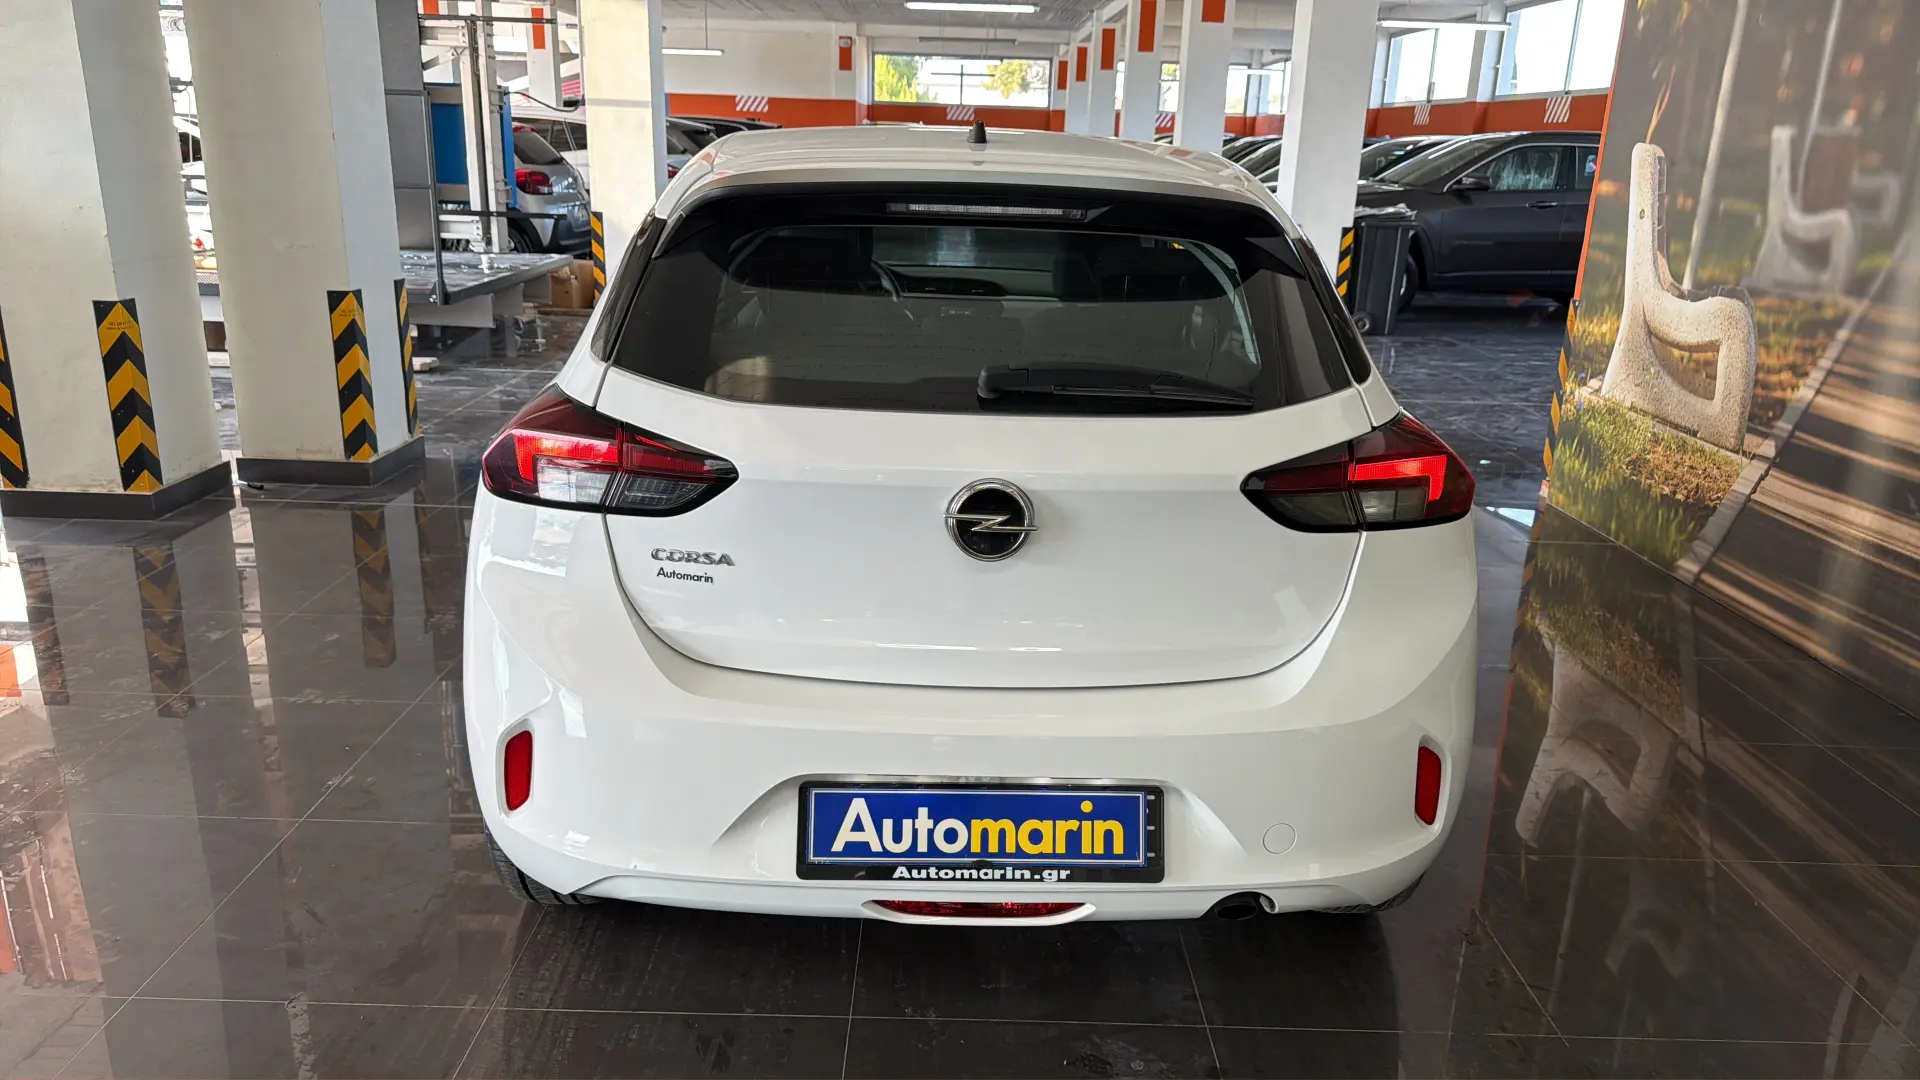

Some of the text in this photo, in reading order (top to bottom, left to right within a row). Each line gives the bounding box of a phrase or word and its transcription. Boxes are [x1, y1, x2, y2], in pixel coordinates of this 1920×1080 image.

[651, 548, 736, 566] CORSA
[656, 566, 714, 584] Automarin
[831, 797, 1124, 855] Automarin
[892, 865, 1071, 882] Automarin.gr
